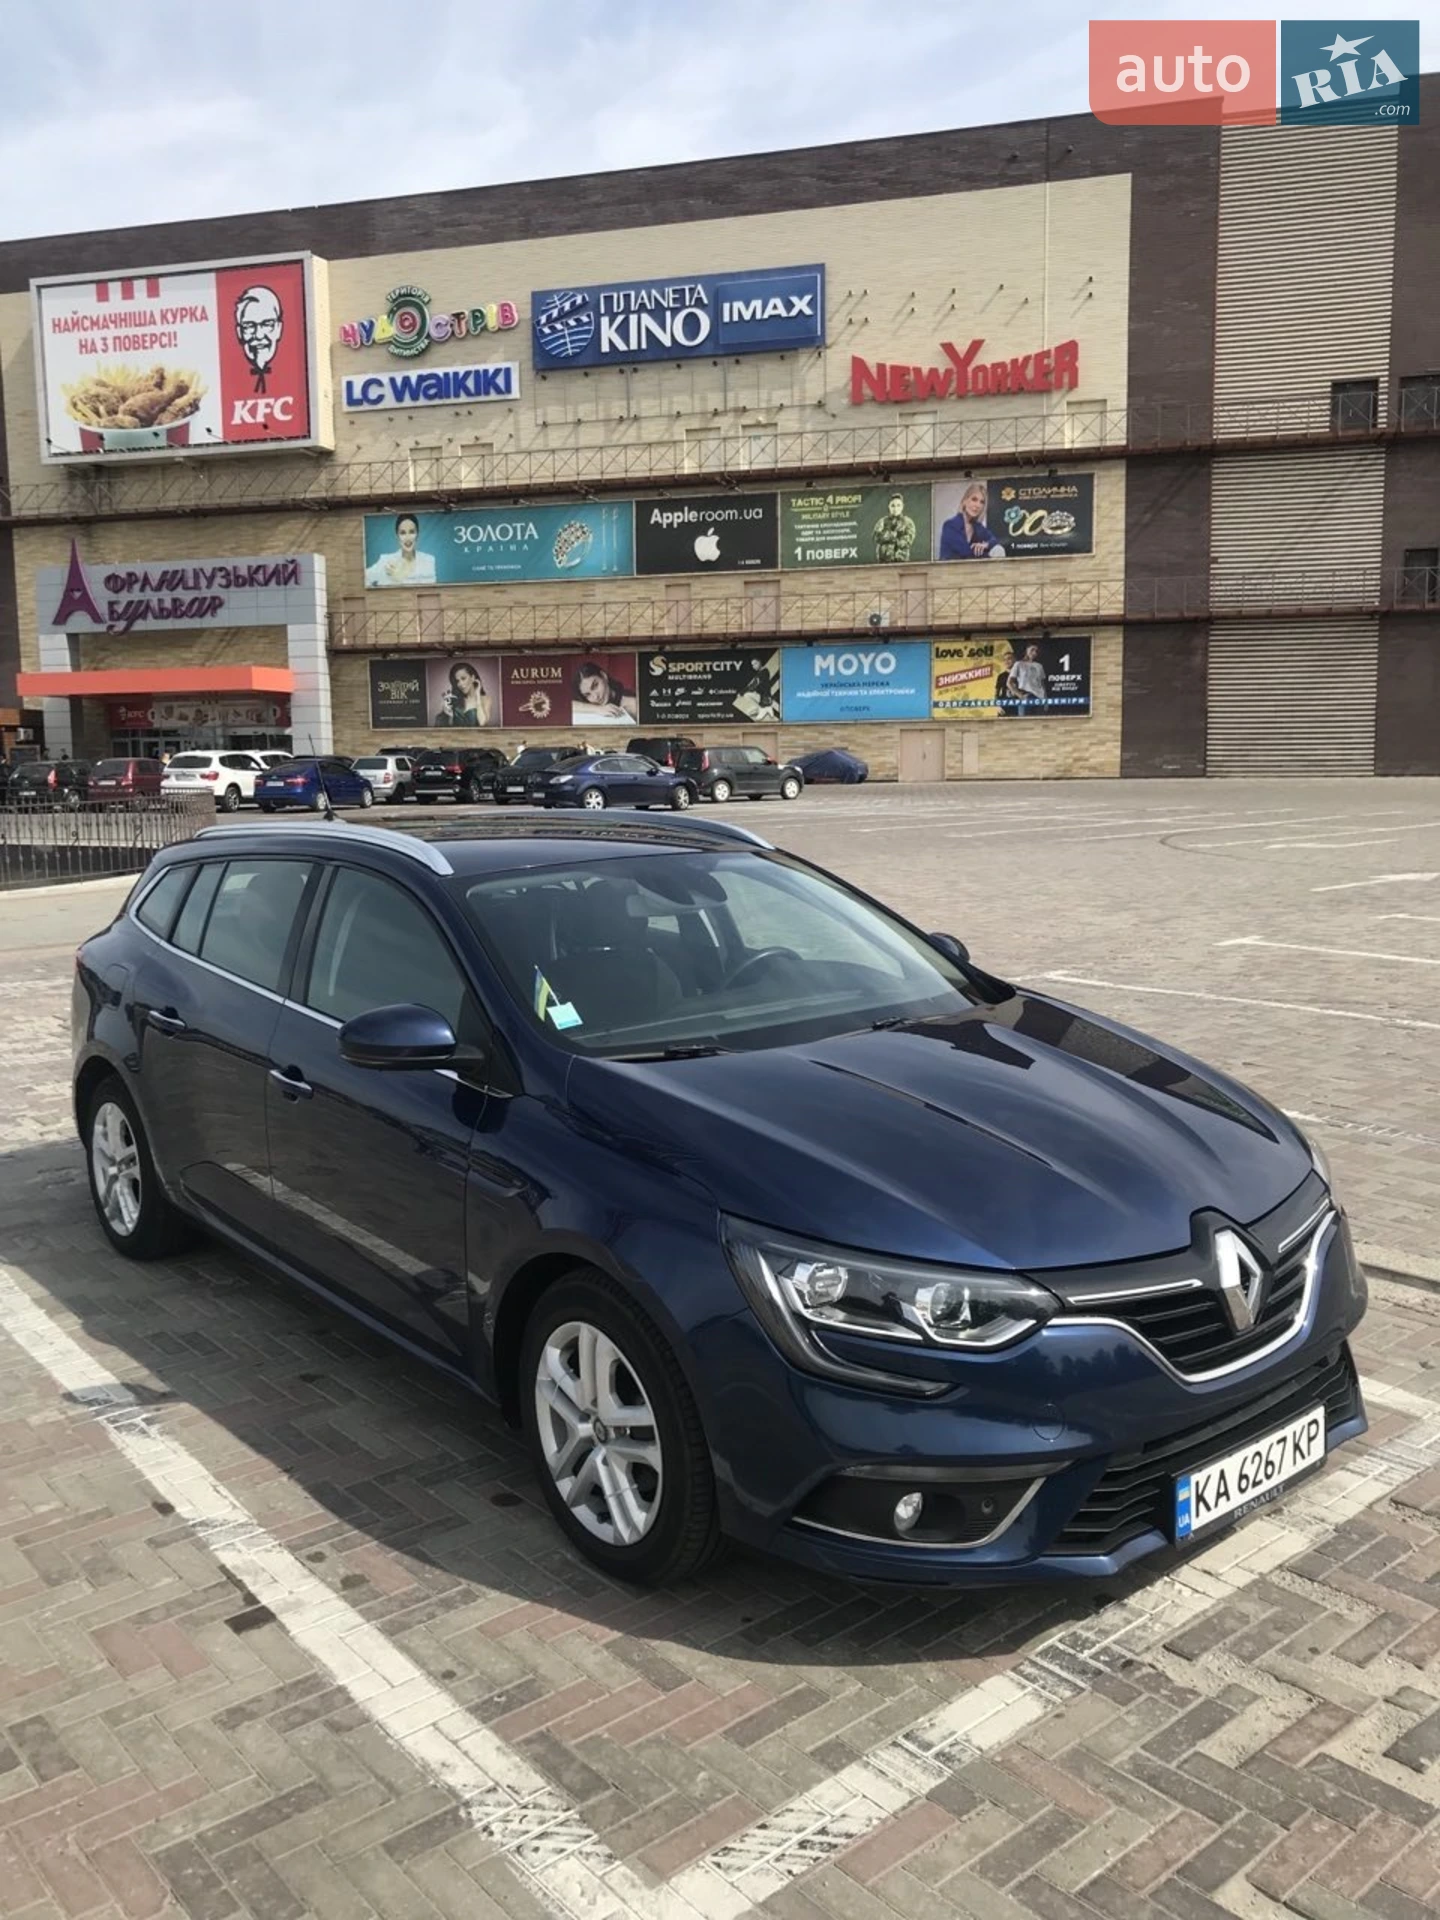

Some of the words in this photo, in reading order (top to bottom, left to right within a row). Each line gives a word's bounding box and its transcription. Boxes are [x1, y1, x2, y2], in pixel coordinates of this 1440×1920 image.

[600, 283, 709, 314] ПЛАНЕТА
[722, 294, 814, 323] IMAX
[51, 310, 158, 334] НАЙСМАЧНІША
[159, 304, 209, 325] КУРКА
[600, 308, 711, 353] KINO
[79, 336, 98, 355] НА
[100, 335, 109, 354] 3
[112, 331, 178, 352] ПОВЕРСІ!
[345, 378, 385, 407] LC
[230, 396, 294, 425] KFC
[791, 496, 824, 507] TACTIC
[826, 494, 834, 505] 4
[835, 494, 862, 504] PROFI
[453, 521, 539, 544] ЗОЛОТА
[794, 546, 803, 562] 1
[806, 546, 858, 561] ПОВЕРХ
[103, 558, 301, 595] ФРАНЦУЗЬКИЙ
[511, 667, 562, 679] AURUM
[668, 660, 744, 672] SPORTCITY
[814, 651, 897, 677] MOYO
[1058, 654, 1071, 672] 1
[1194, 1468, 1231, 1519] KA
[1237, 1435, 1288, 1495] 6267
[1292, 1418, 1320, 1467] KP
[1233, 1484, 1286, 1519] RENAULT
[1178, 1514, 1190, 1528] UA
